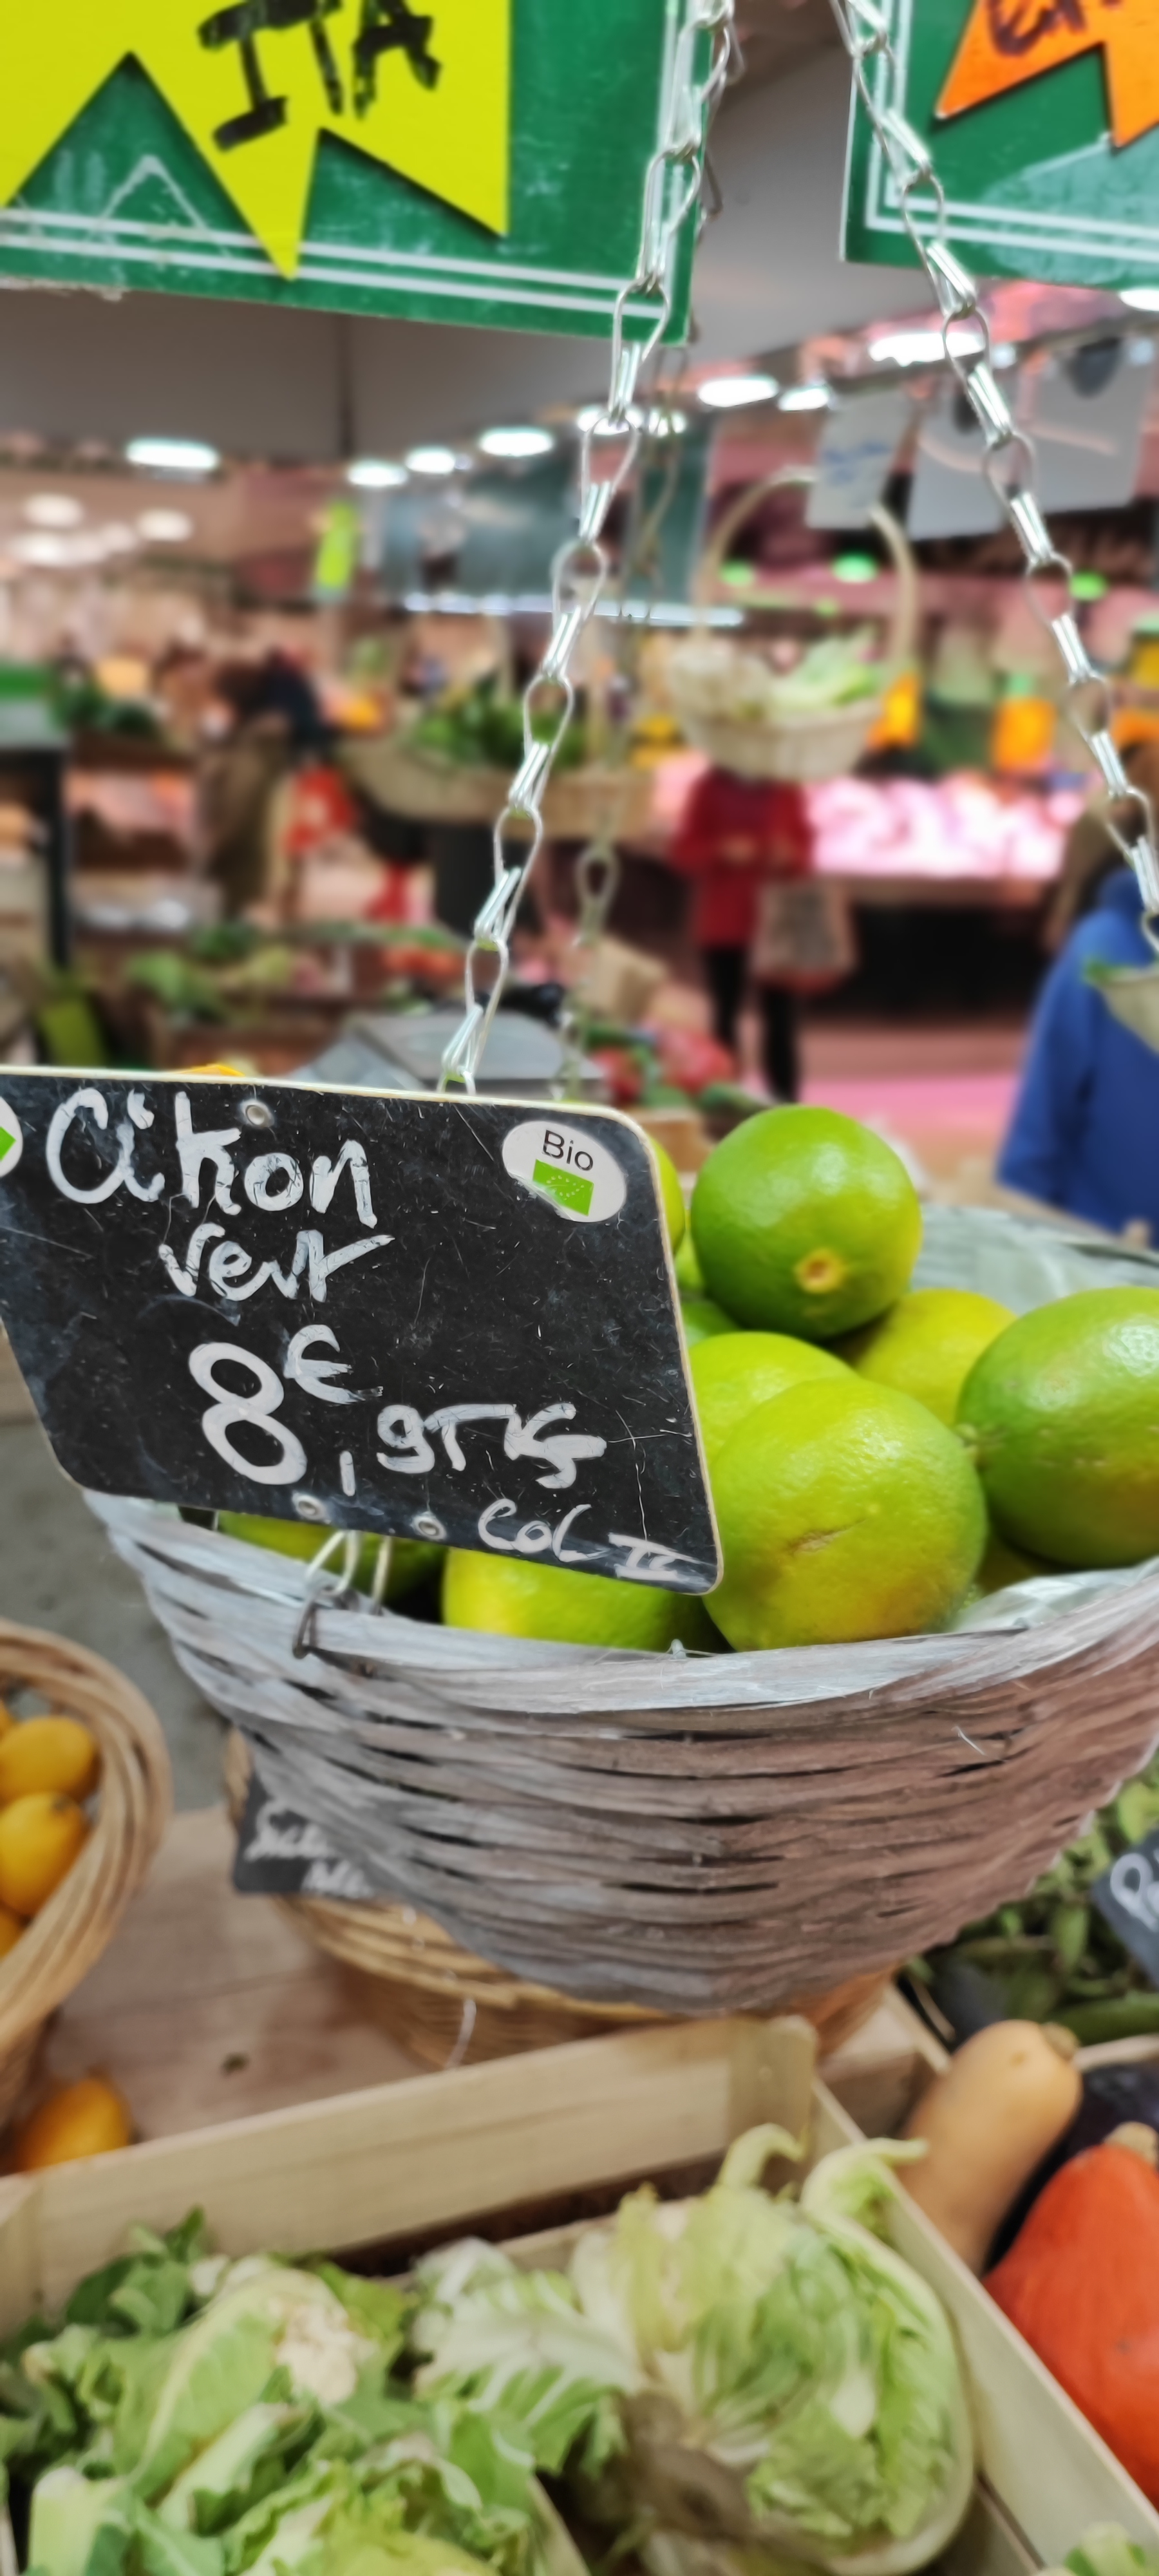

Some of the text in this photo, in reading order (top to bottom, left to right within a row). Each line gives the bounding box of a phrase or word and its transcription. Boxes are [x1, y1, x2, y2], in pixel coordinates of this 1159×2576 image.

[197, 0, 443, 155] ITA
[46, 1087, 377, 1229] Citron
[543, 1130, 593, 1171] Bio
